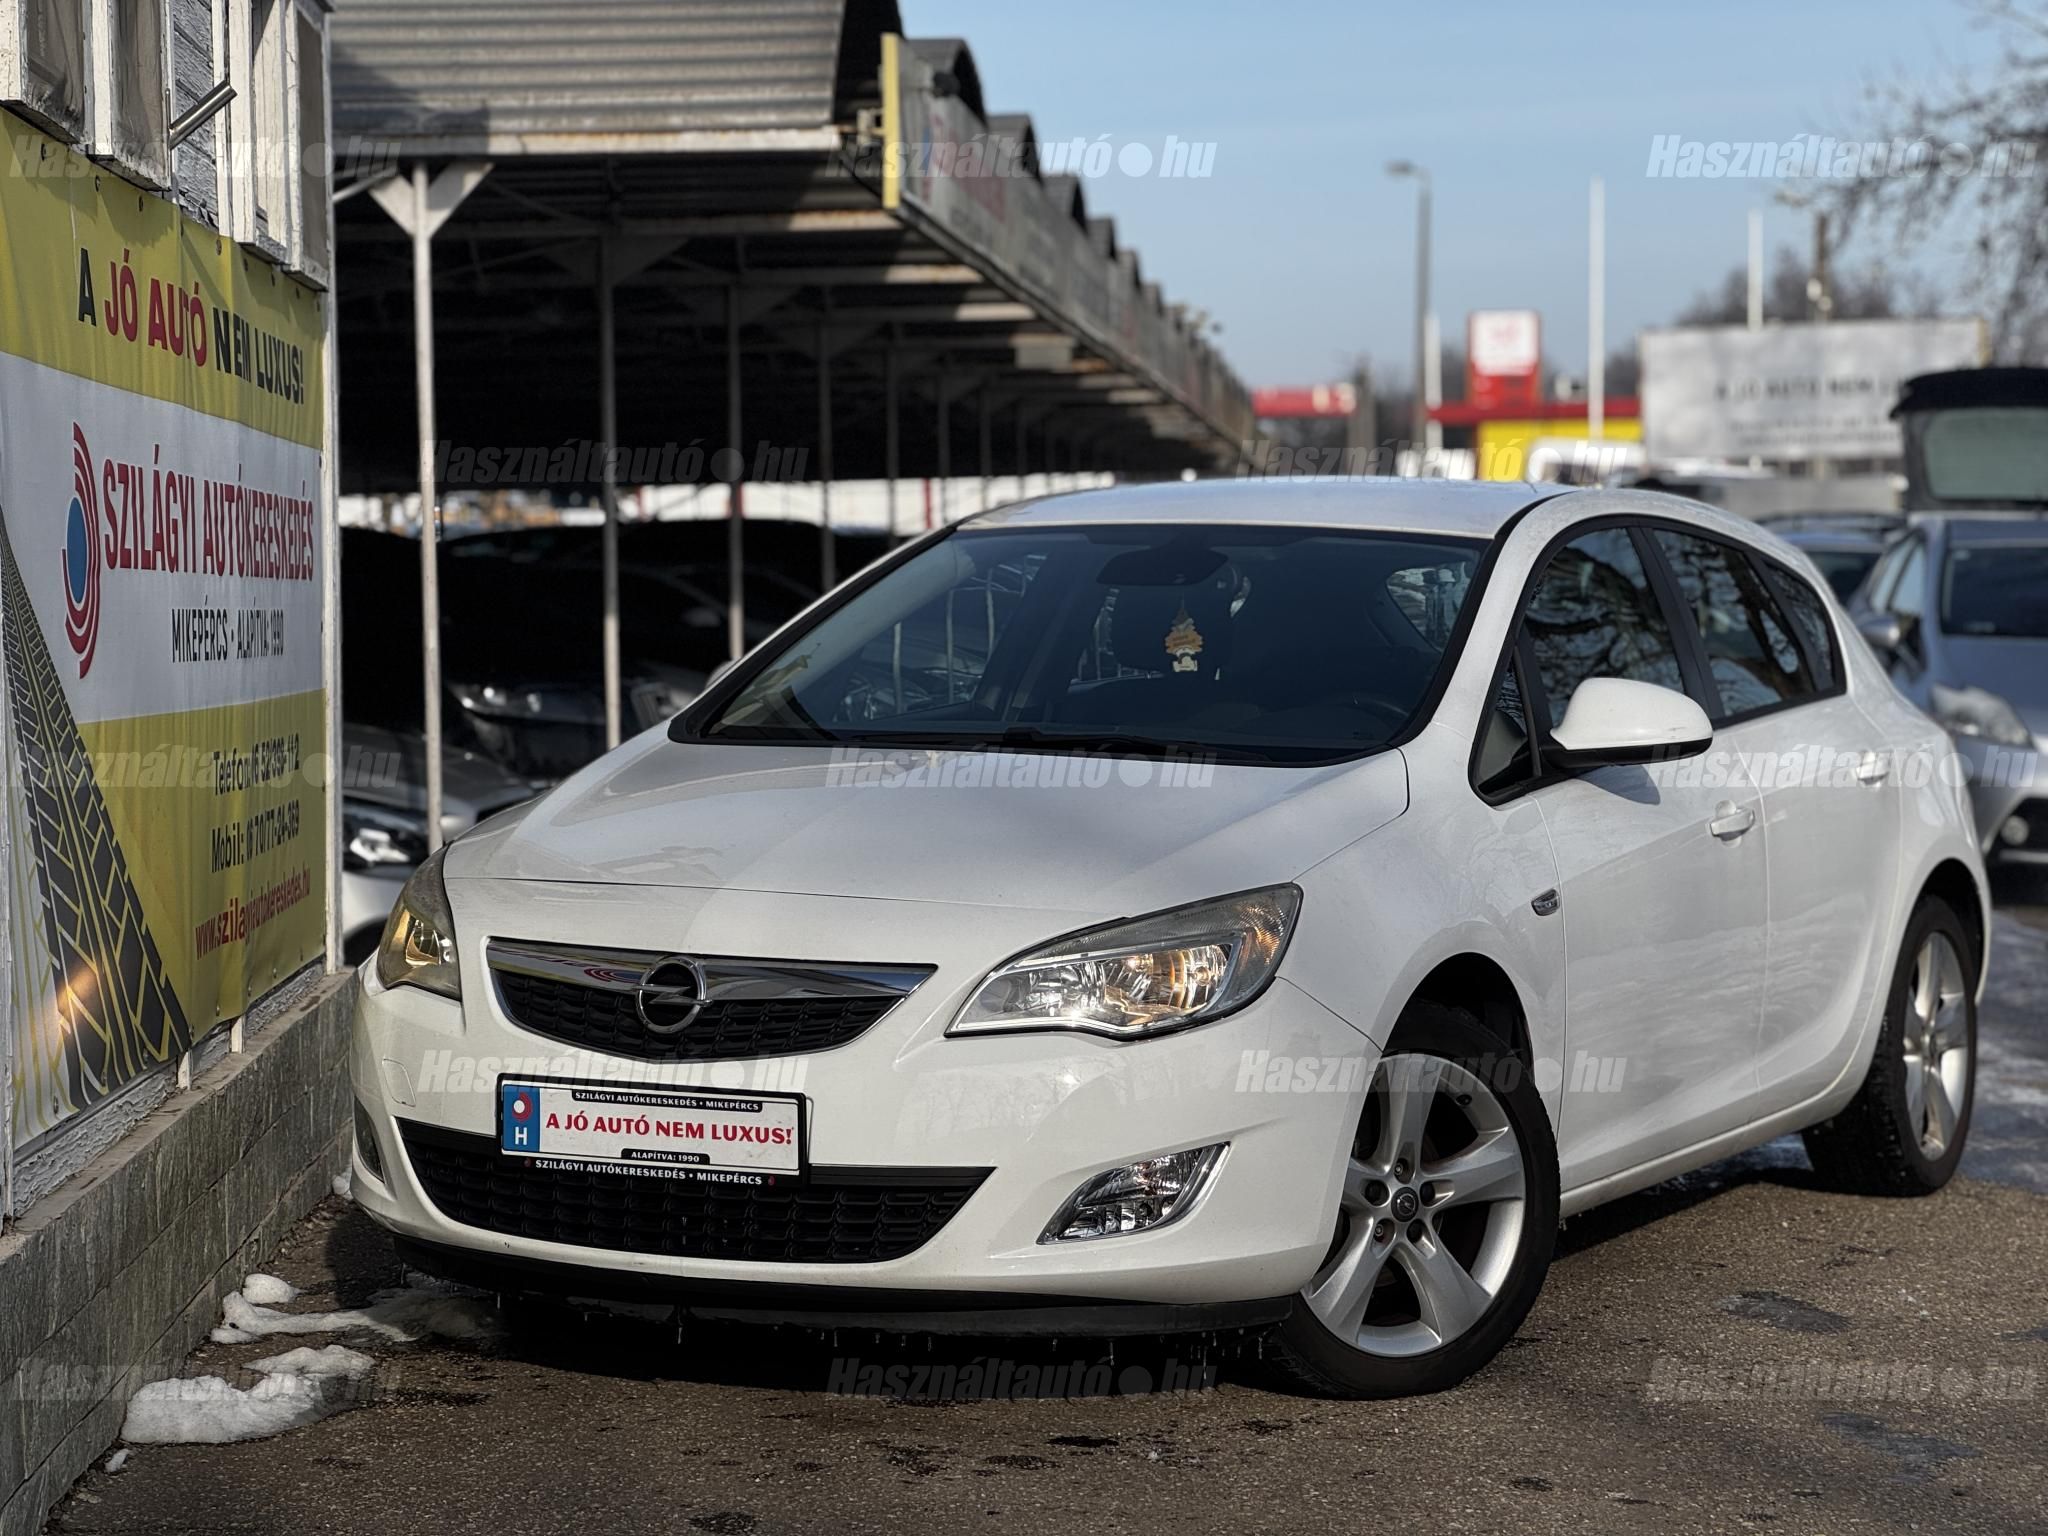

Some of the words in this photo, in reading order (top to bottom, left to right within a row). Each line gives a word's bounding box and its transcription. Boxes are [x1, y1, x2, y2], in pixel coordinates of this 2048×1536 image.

[78, 248, 97, 327] A
[104, 248, 138, 342] JÓ
[148, 278, 207, 367] AUTÓ
[213, 307, 251, 383] NEM
[255, 327, 304, 404] LUXUS!
[102, 444, 197, 574] SZILÁGYI
[203, 464, 313, 581] AUTÓKERESKEDÉS
[171, 595, 228, 663] MIKEPÉRCS
[212, 822, 244, 873] Mobil:
[575, 1091, 615, 1102] SZILÁGYI
[616, 1093, 697, 1107] AUTÓKERESKEDÉS
[705, 1100, 759, 1111] MIKEPÉRCS
[514, 1127, 528, 1146] H
[546, 1113, 560, 1129] A
[564, 1110, 589, 1131] JÓ
[593, 1115, 650, 1136] AUTÓ
[655, 1120, 704, 1139] NEM
[711, 1123, 792, 1145] LUXUS!
[535, 1158, 584, 1172] SZILÁGYI
[586, 1161, 686, 1180] AUTÓKERESKEDÉS
[696, 1171, 762, 1185] MIKEPÉRCS
[631, 1151, 677, 1161] ALAPÍTVA:
[678, 1154, 700, 1163] 1990
